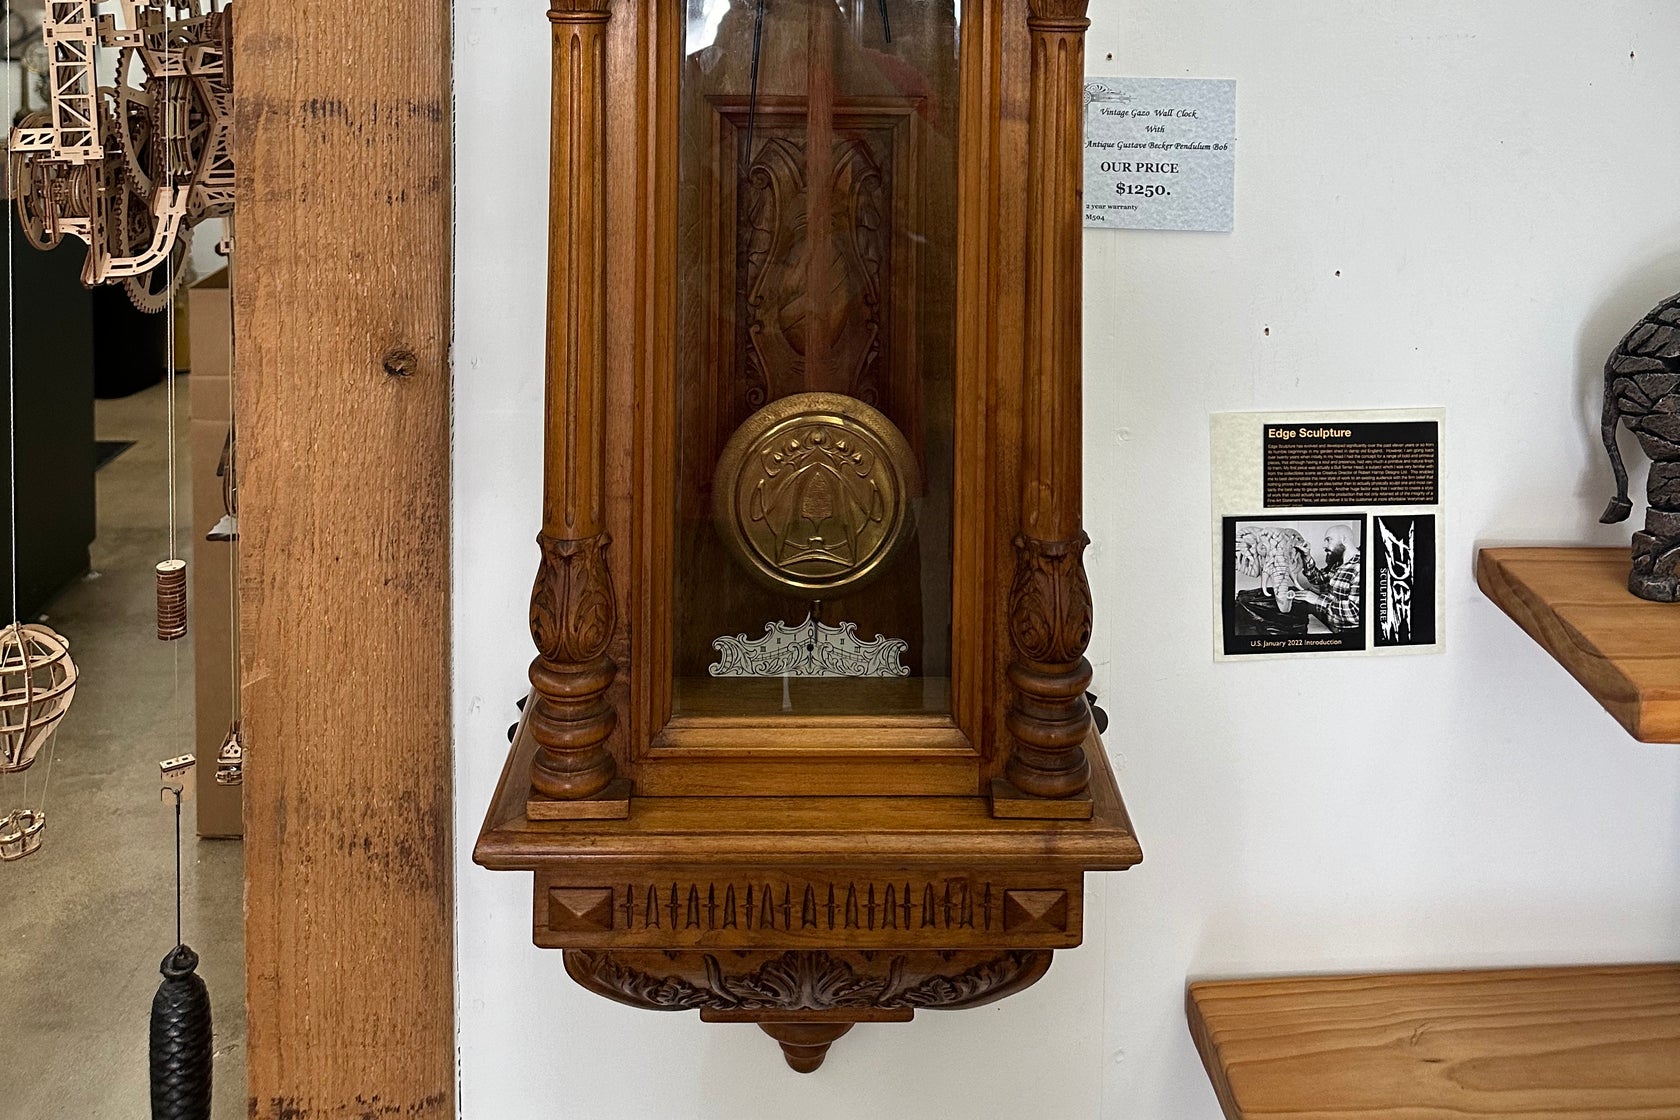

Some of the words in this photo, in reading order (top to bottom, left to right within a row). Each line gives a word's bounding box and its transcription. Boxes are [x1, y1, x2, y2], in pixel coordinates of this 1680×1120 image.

[1100, 108, 1129, 118] Vintage
[1154, 109, 1173, 117] Wall
[1176, 109, 1198, 119] Clock
[1085, 141, 1115, 149] Antique
[1117, 141, 1146, 150] Gustave
[1148, 142, 1173, 151] Becker
[1174, 142, 1210, 150] Pendulum
[1213, 143, 1228, 151] Bob
[1101, 162, 1132, 172] OUR
[1136, 162, 1179, 174] PRICE
[1116, 182, 1171, 197] $1250.
[1268, 428, 1296, 440] Edge
[1299, 427, 1352, 439] Sculpture
[1380, 568, 1388, 622] SCULPTURE
[1263, 640, 1286, 648] January
